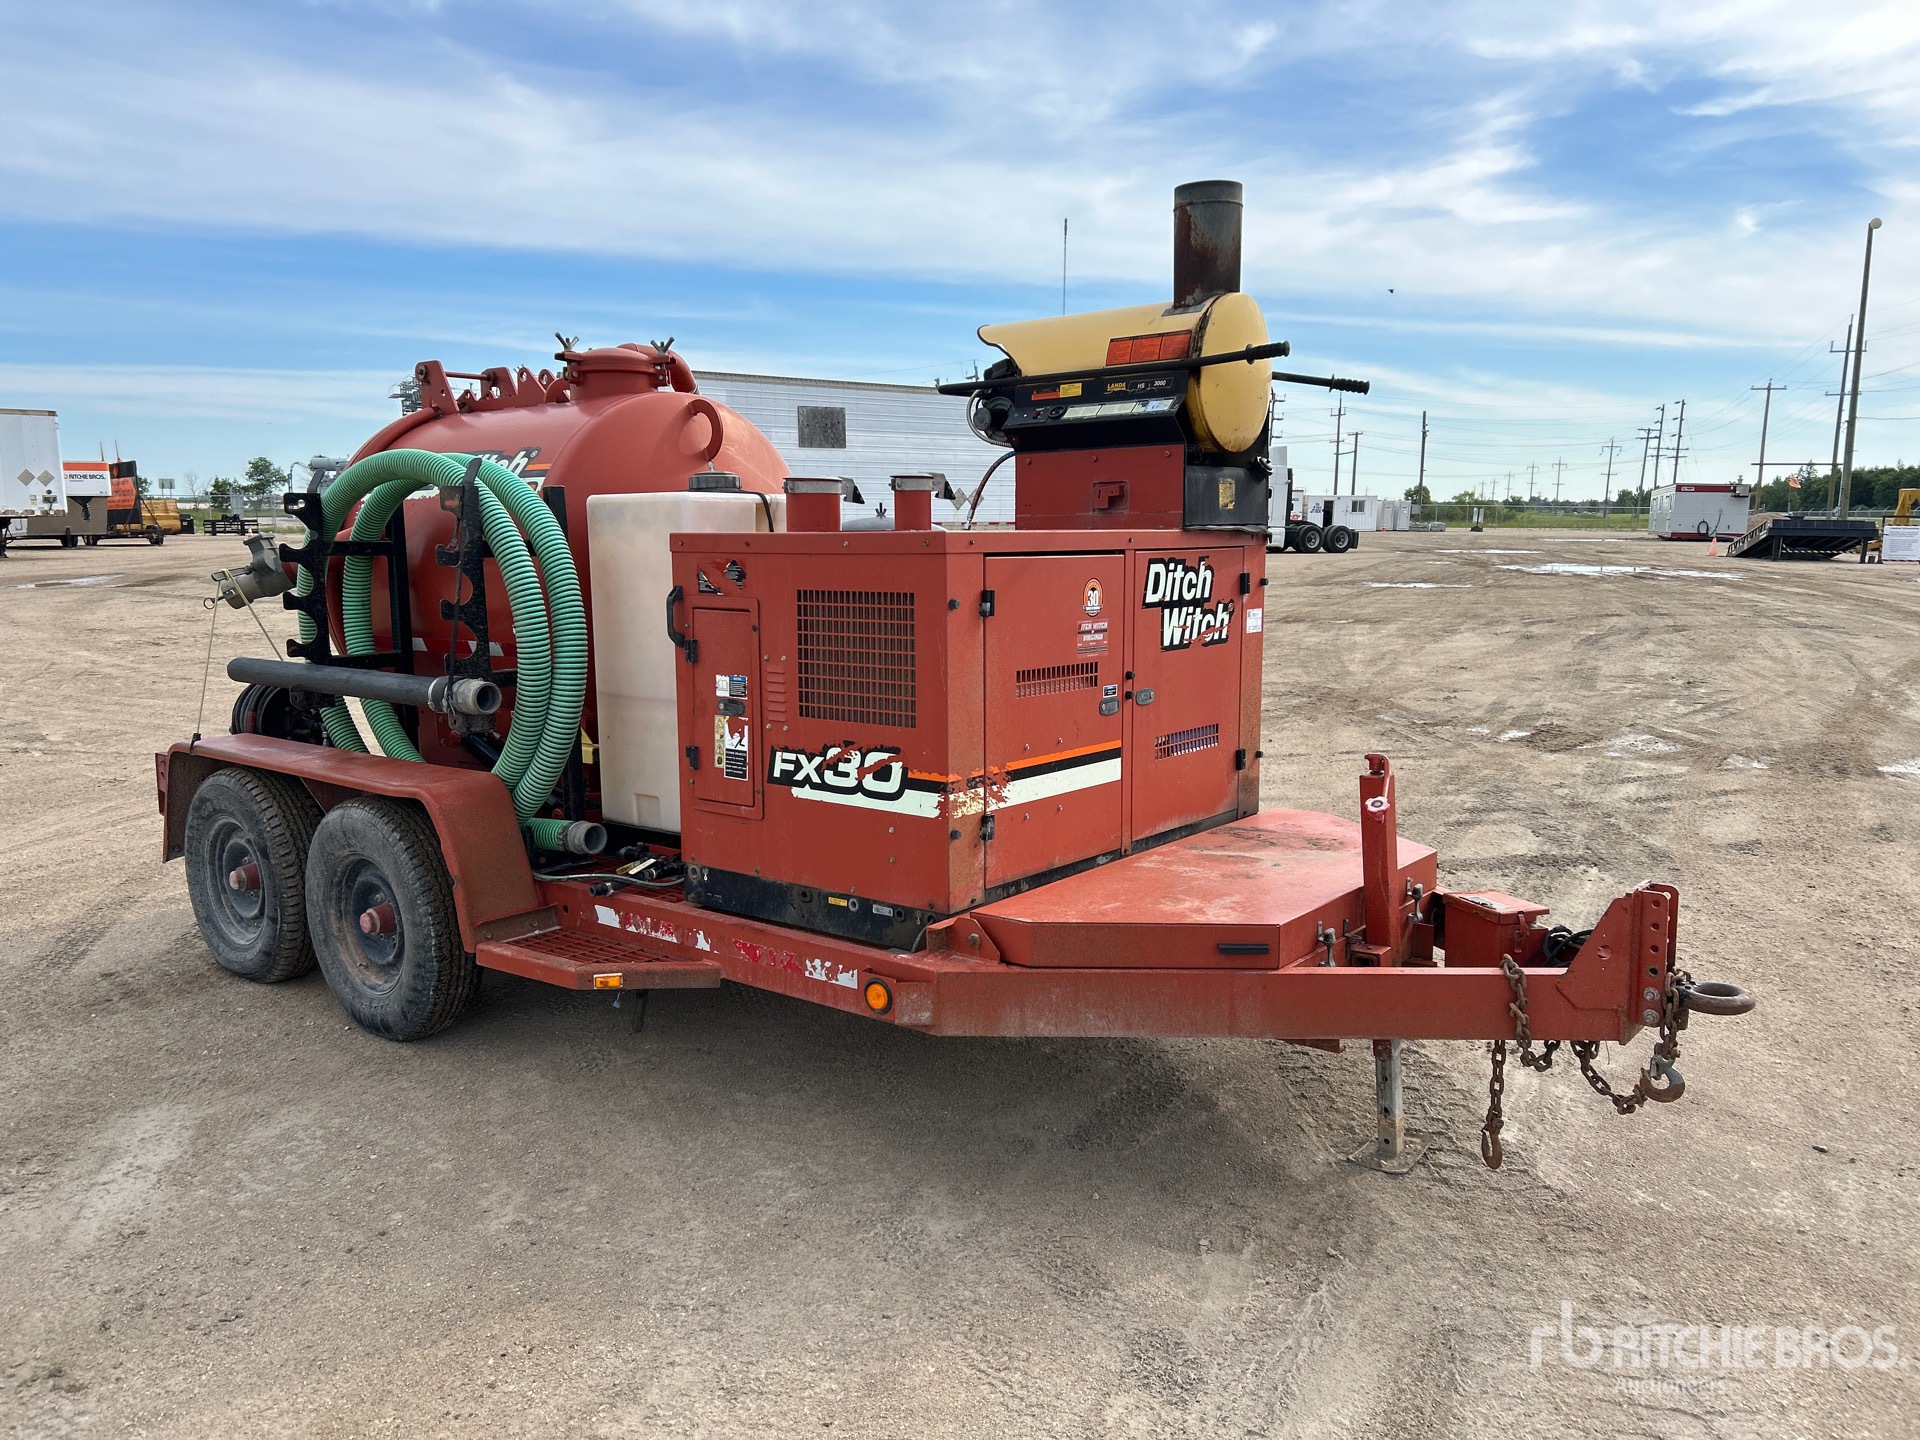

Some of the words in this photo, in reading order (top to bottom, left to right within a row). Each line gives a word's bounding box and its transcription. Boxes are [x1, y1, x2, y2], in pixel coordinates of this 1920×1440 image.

[1107, 382, 1126, 390] LANDA
[1087, 590, 1099, 606] 30
[1145, 561, 1212, 603] Ditch
[1163, 603, 1231, 647] Witch
[773, 747, 903, 794] FX30
